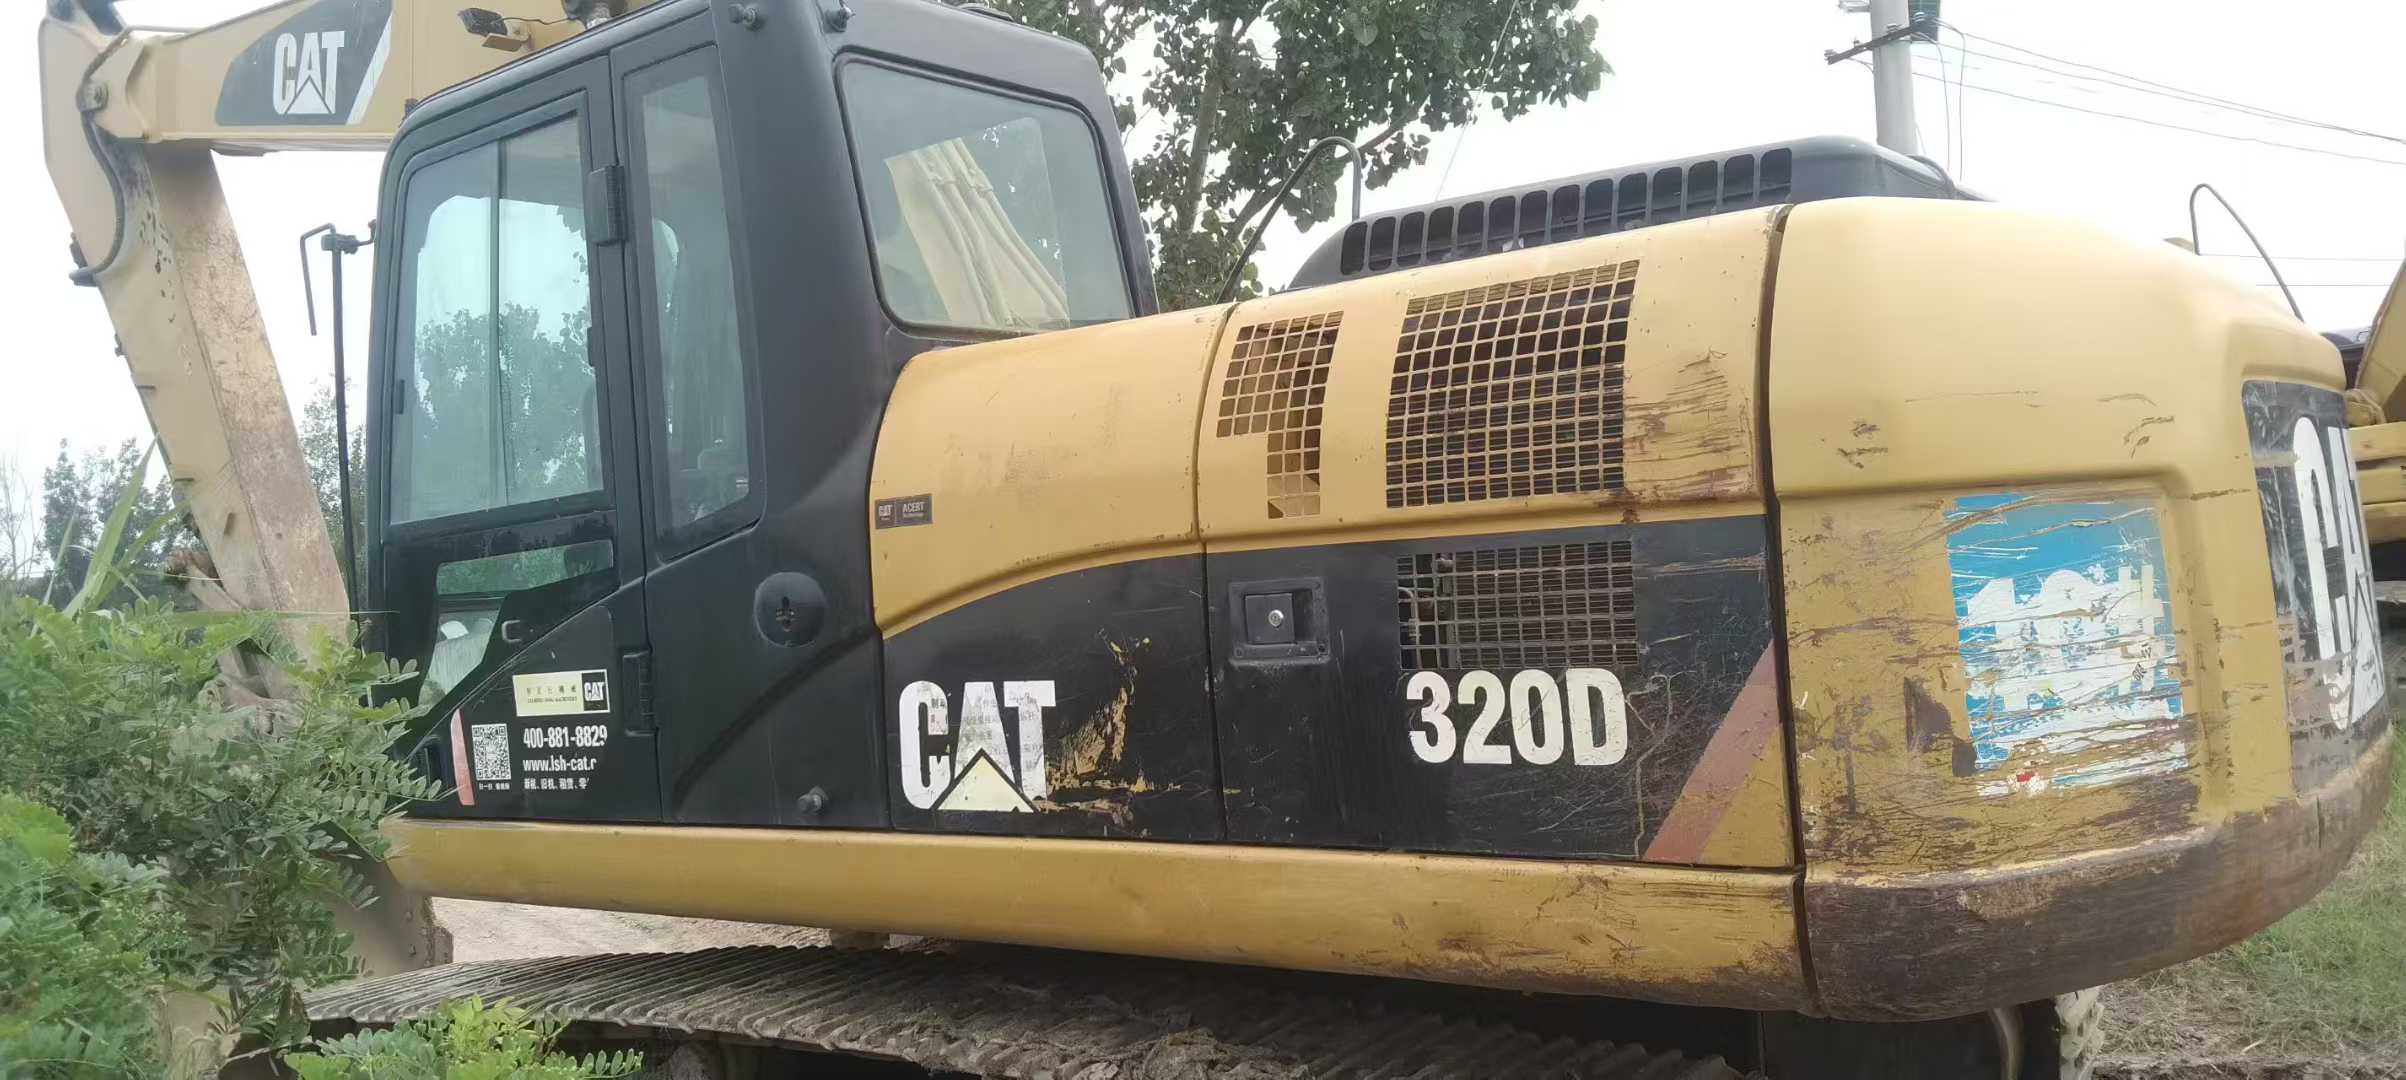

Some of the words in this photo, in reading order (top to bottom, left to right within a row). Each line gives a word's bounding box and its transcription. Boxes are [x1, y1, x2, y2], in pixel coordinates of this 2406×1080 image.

[273, 31, 345, 114] CAT
[902, 502, 925, 513] ACERT
[584, 682, 605, 701] CAT
[1406, 668, 1628, 766] 320D
[523, 725, 608, 748] 400-881-8829
[899, 680, 1056, 811] CAT
